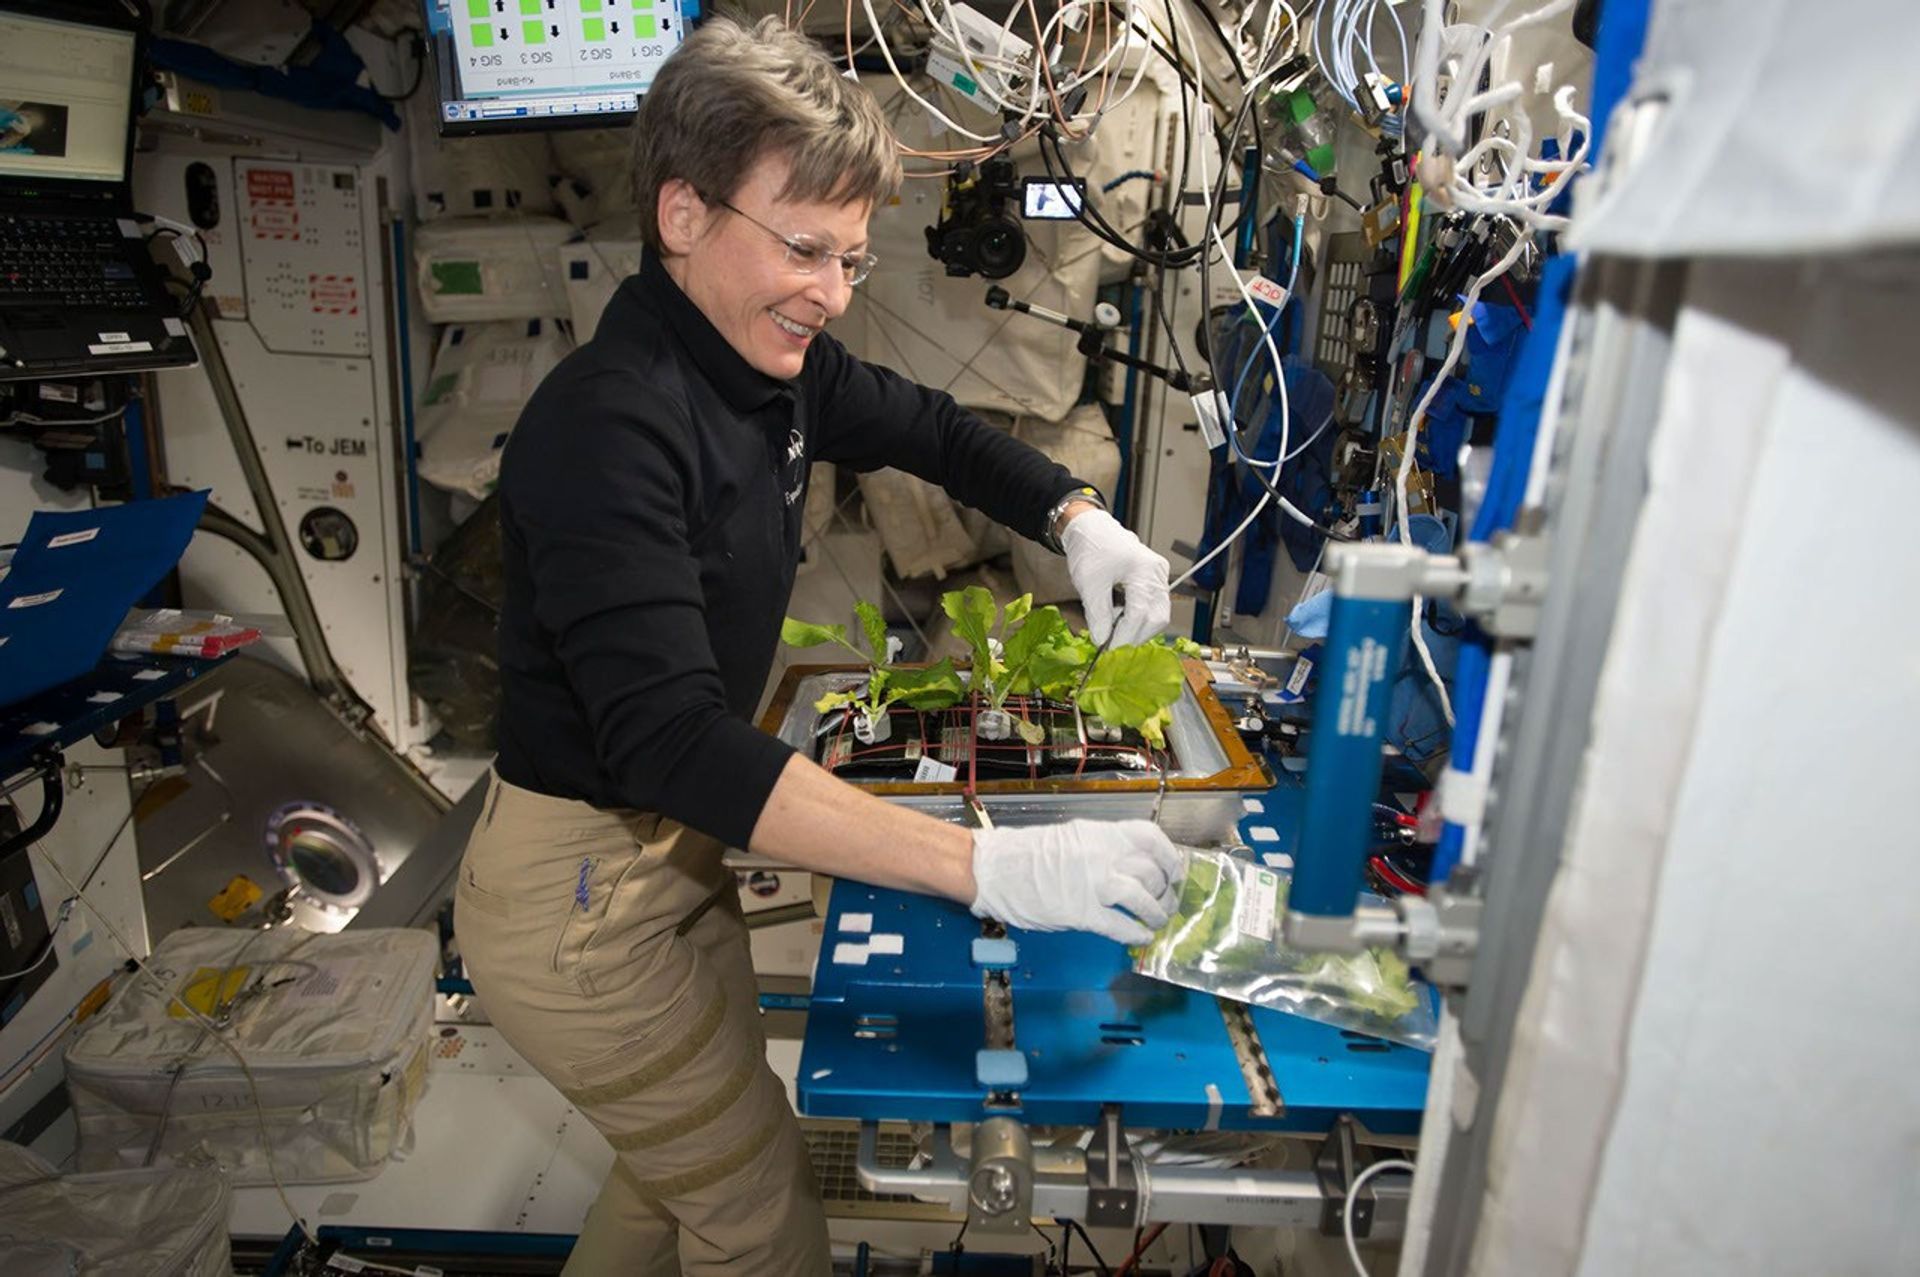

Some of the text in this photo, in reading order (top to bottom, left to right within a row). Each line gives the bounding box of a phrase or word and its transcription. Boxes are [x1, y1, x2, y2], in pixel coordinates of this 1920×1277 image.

[520, 51, 553, 64] S/G 3
[580, 47, 613, 61] S/G 2
[643, 44, 663, 58] S/G
[470, 54, 503, 67] S/G 4
[304, 436, 368, 456] To JEM
